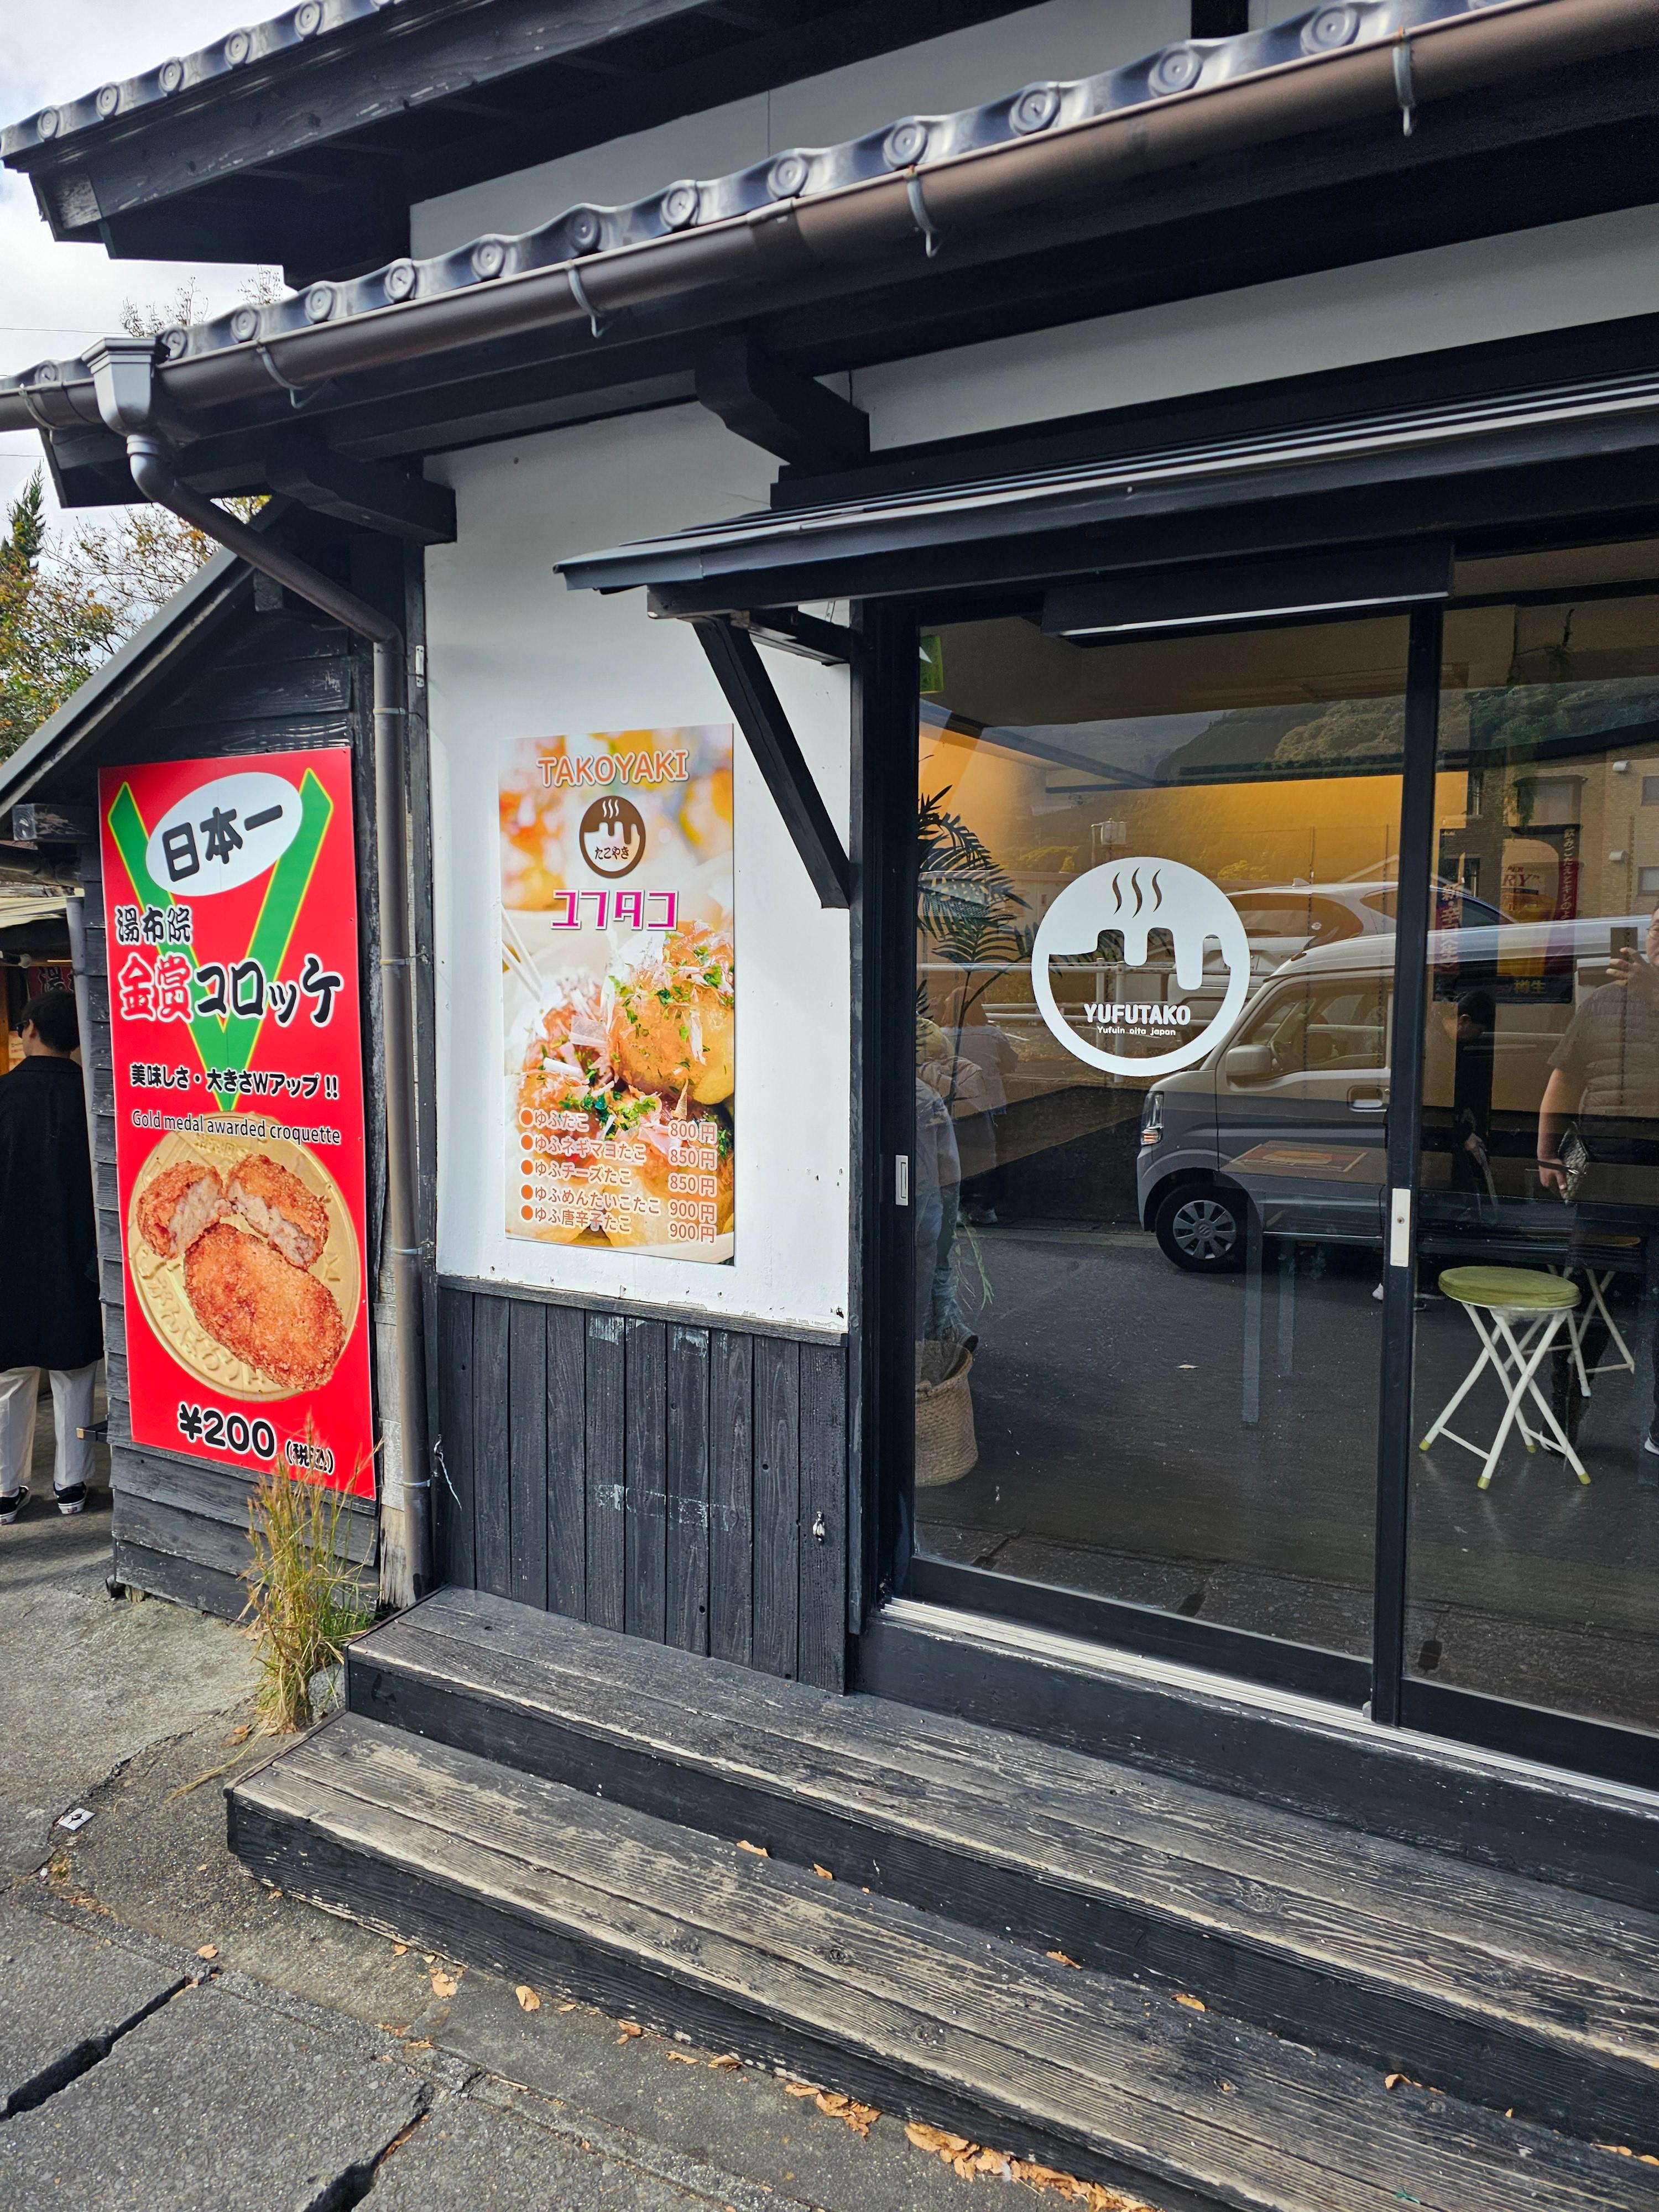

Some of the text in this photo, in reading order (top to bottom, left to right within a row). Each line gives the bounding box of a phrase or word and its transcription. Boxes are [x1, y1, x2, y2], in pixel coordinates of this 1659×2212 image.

[537, 750, 689, 786] TAKOYAKI
[161, 805, 284, 883] 日本一
[594, 846, 629, 860] たこやき
[550, 889, 679, 931] ユフタコ
[117, 906, 192, 945] 湯布院
[119, 954, 343, 1026] 金賞コロッケ
[1084, 1003, 1191, 1025] YUFUTAKO
[1150, 1027, 1176, 1036] japan
[132, 1109, 160, 1129] Gold
[164, 1115, 204, 1133] medal
[207, 1119, 266, 1138] awarded
[269, 1125, 341, 1145] croquette
[534, 1111, 589, 1132] ゆふたこ
[534, 1135, 647, 1162] ゆふネギマヨたこ
[534, 1161, 632, 1187] ゆふチーズたこ
[534, 1185, 661, 1215] ゆふめんたいこたこ
[534, 1206, 631, 1233] ゆふ唐辛子たこ
[178, 1402, 276, 1459] ¥200
